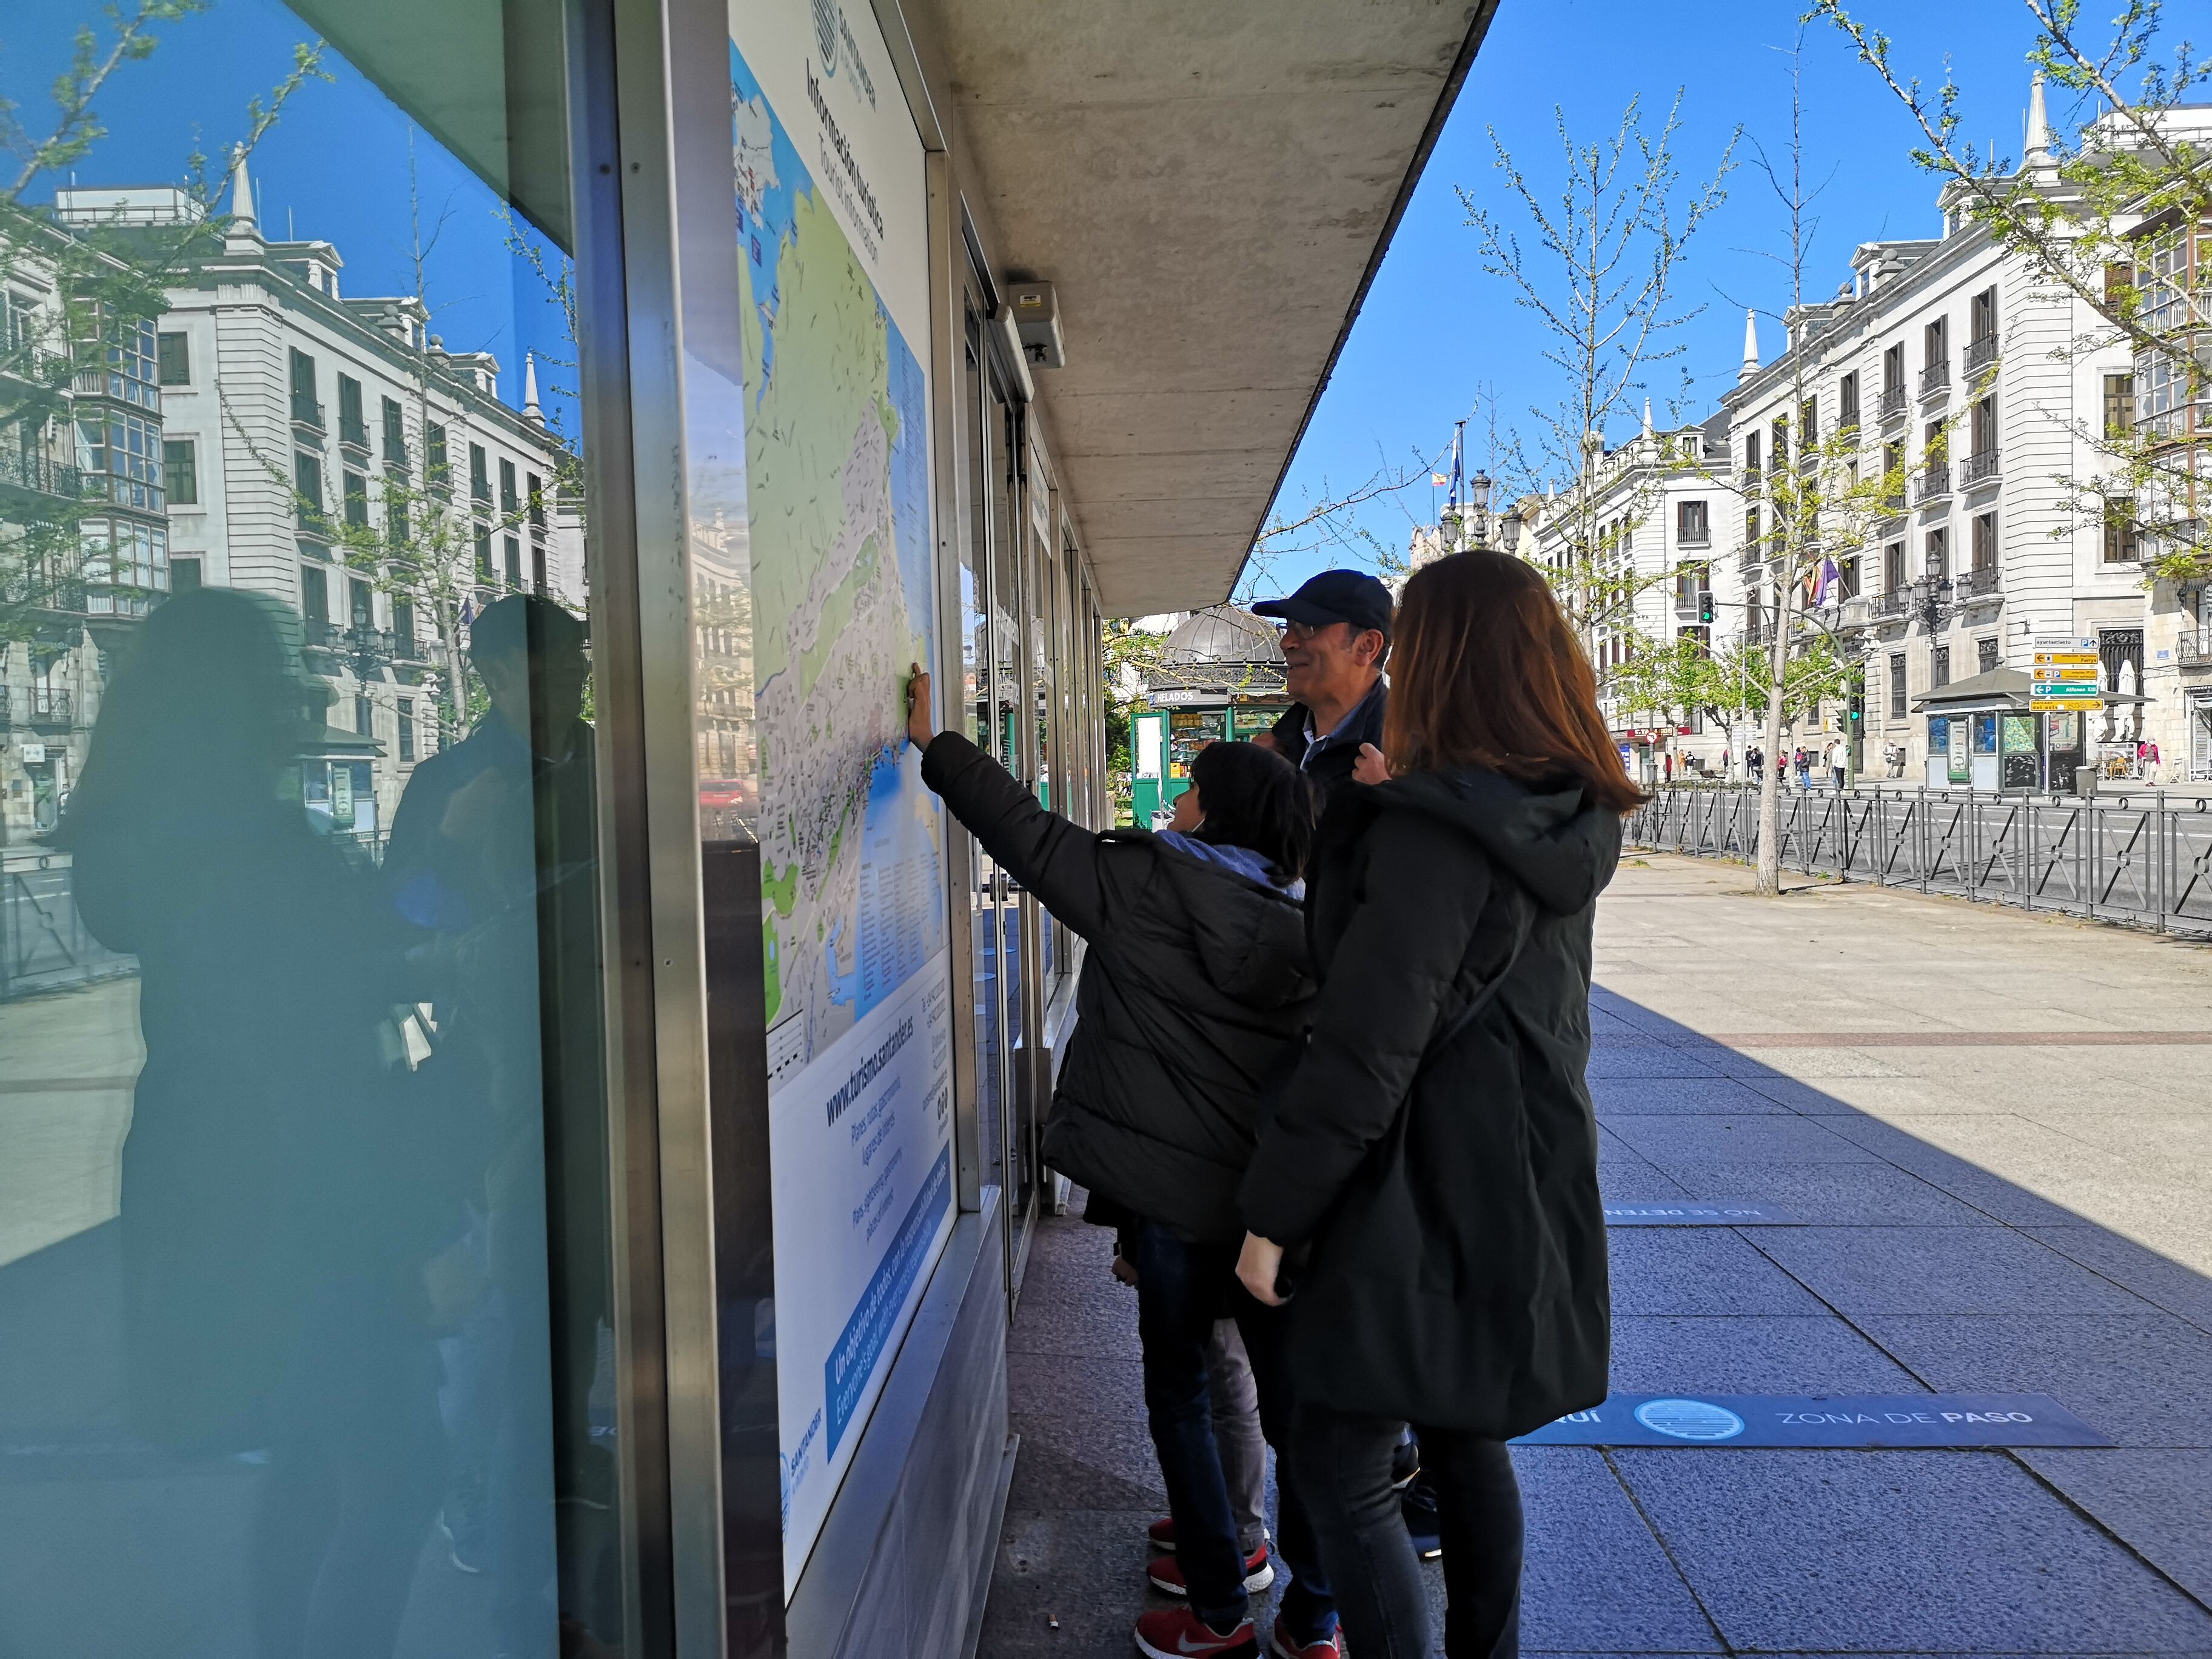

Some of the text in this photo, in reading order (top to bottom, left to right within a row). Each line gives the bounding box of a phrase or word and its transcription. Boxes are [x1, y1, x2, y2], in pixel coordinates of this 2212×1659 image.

[839, 7, 876, 113] SANTANDER
[806, 57, 884, 241] Información turística
[818, 132, 879, 267] Tourist information
[1157, 691, 1193, 702] HELADOS
[827, 1016, 913, 1127] www.turismo.santander.es
[836, 1353, 845, 1384] Un
[846, 1309, 869, 1366] objetivo
[870, 1292, 877, 1320] de
[837, 1352, 867, 1425] Everyone's
[1774, 1412, 1880, 1424] ZONA
[1883, 1412, 1937, 1424] DE
[1940, 1412, 2034, 1423] PASO
[791, 1407, 821, 1476] SANTANDER
